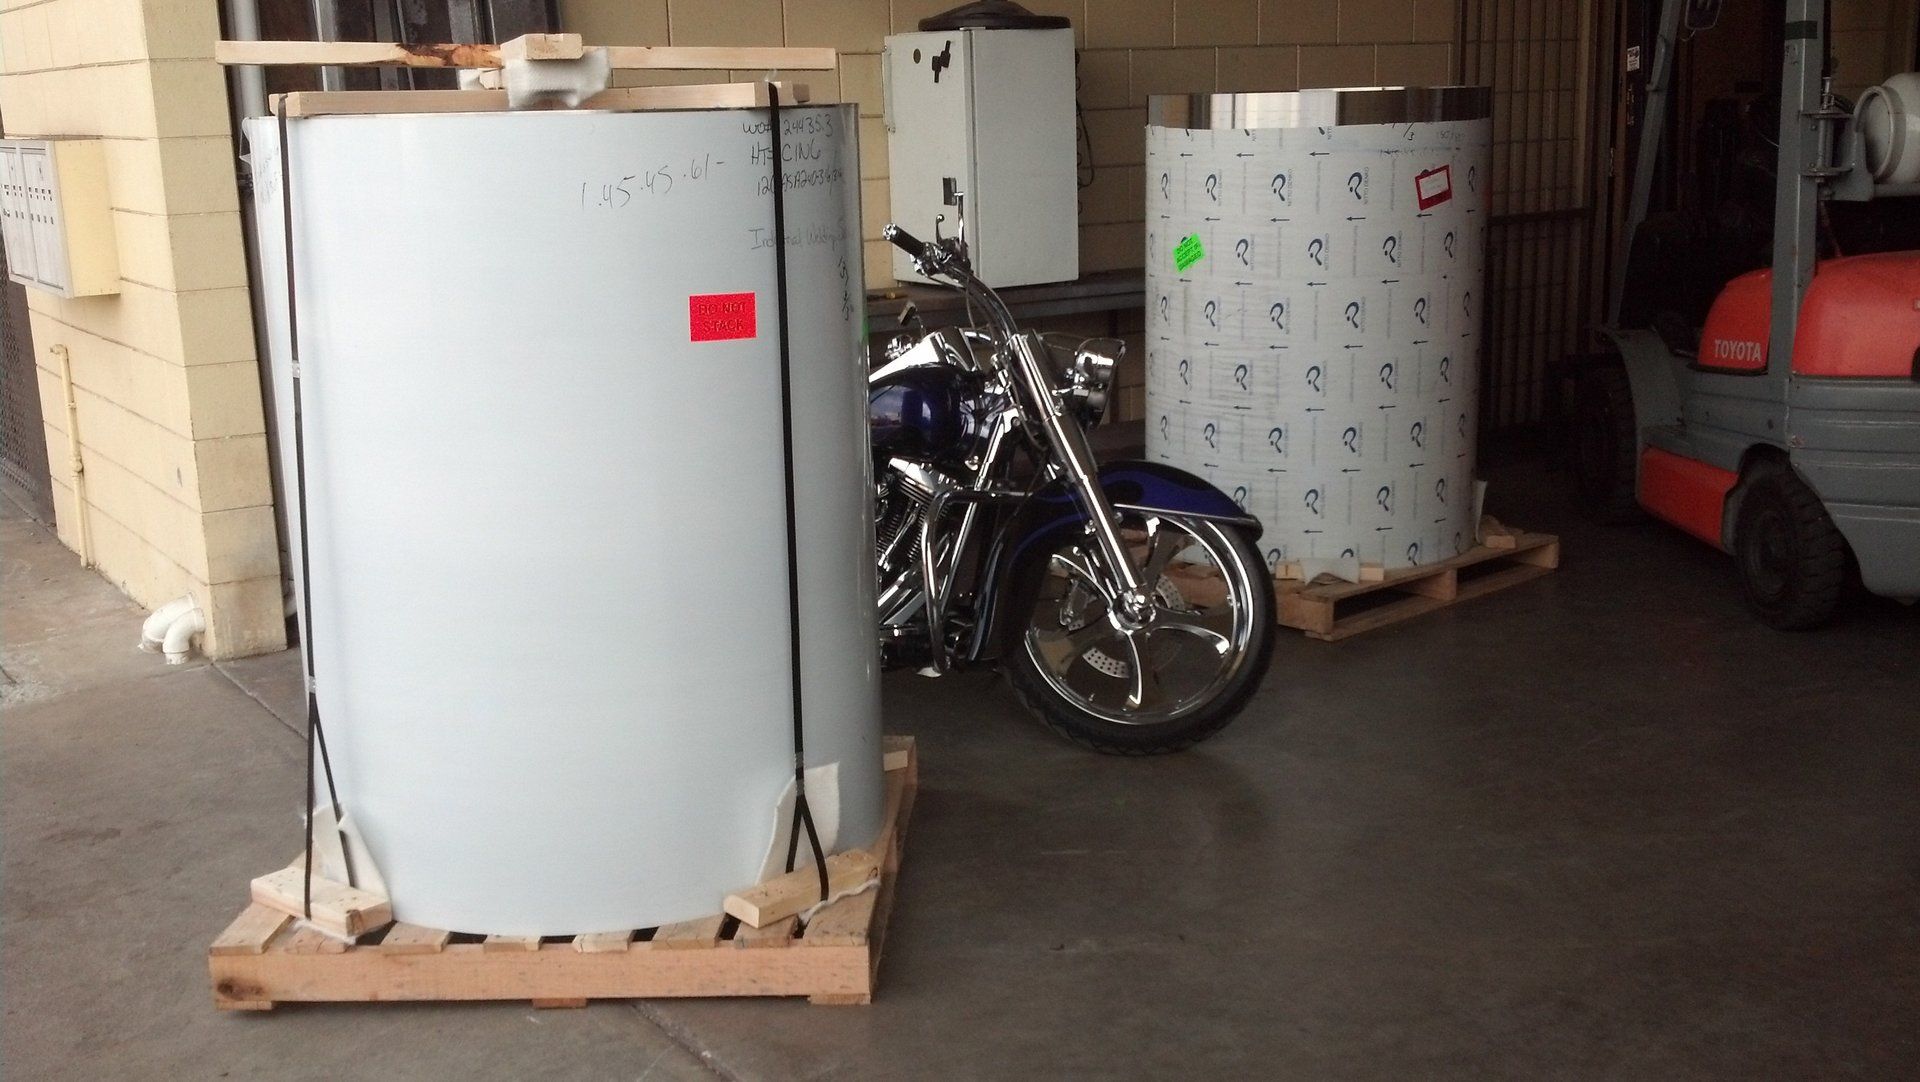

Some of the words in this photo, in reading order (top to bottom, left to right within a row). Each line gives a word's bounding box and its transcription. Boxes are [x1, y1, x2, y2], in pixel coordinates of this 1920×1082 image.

[698, 303, 718, 316] DO
[722, 301, 746, 314] NOT
[703, 318, 744, 332] STACK
[1714, 338, 1762, 362] TOYOTA
